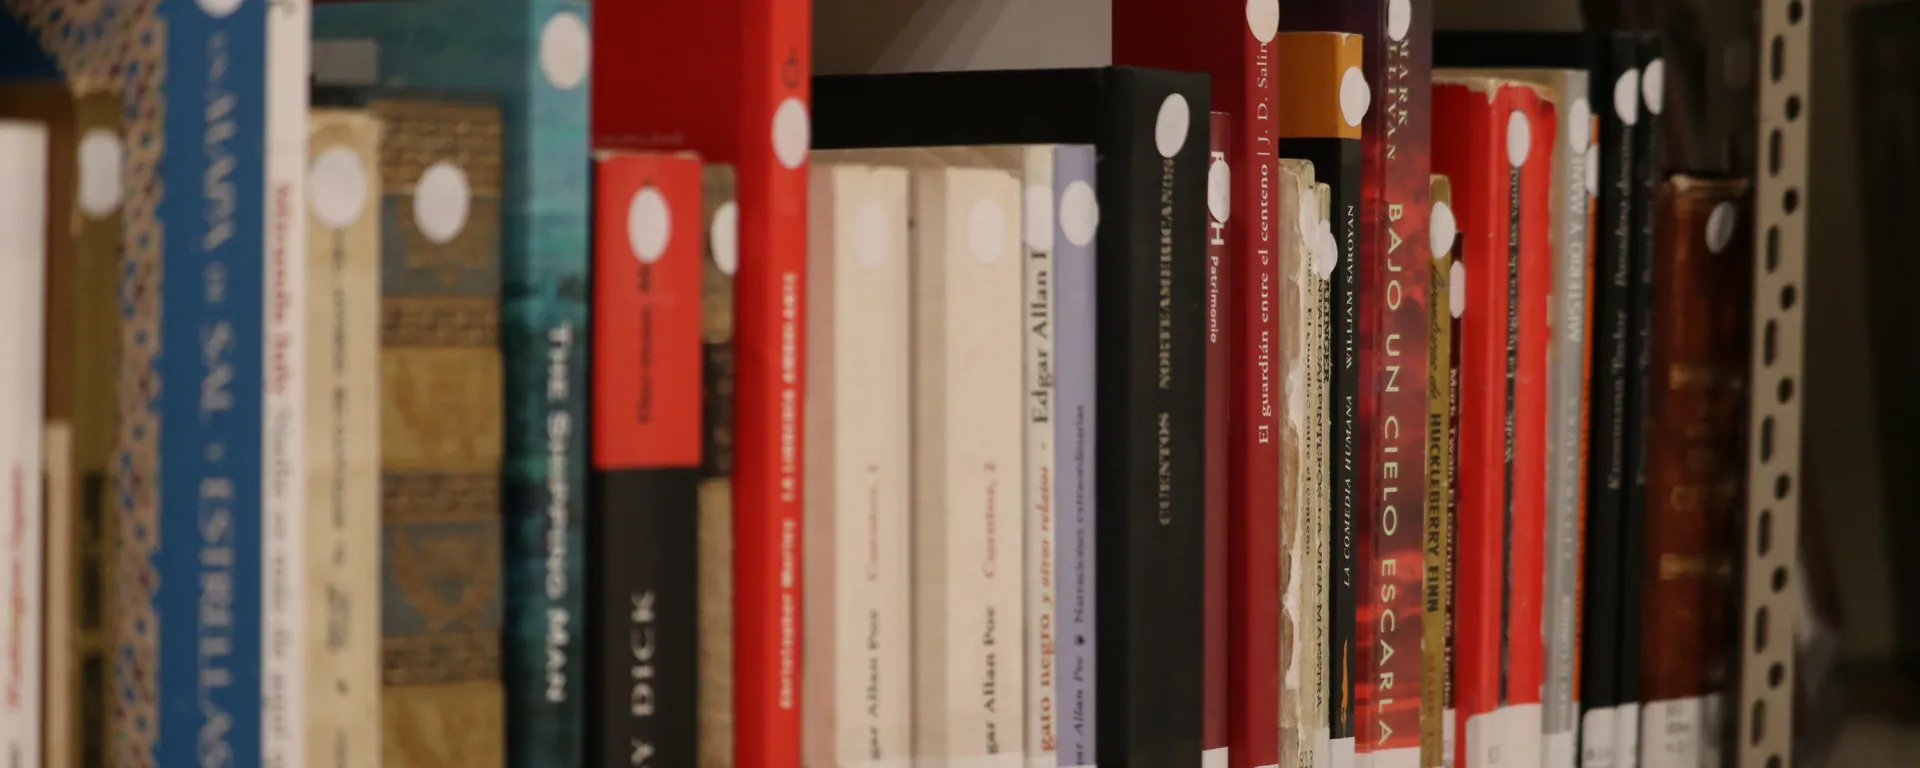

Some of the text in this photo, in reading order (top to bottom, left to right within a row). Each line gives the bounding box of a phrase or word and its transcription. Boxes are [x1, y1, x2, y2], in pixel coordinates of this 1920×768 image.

[1258, 98, 1269, 121] D.
[1258, 129, 1270, 145] J.
[1259, 164, 1269, 242] centeno
[1258, 248, 1268, 266] el
[1031, 270, 1049, 341] Allan
[1209, 255, 1220, 343] Patrimonio
[1259, 272, 1268, 323] entre
[1031, 348, 1054, 424] Edgar
[1257, 330, 1271, 417] guardián
[1343, 204, 1355, 588] LA COMEDIA HUMANA WILLIAM SAROYAN
[1072, 404, 1085, 525] extraordinarias
[1258, 424, 1268, 444] El
[1036, 465, 1051, 532] relatos
[1157, 412, 1172, 526] CUENTOS
[1378, 203, 1403, 746] BAJO UN CIELO ESCARLA
[1428, 413, 1441, 557] HUCKLEBERRY
[544, 321, 575, 703] THE SHIPPING MAN
[1038, 538, 1050, 589] otros
[1072, 527, 1084, 623] Narraciones
[1427, 565, 1439, 614] FINN
[631, 588, 656, 718] DICK
[866, 608, 880, 651] Poe
[982, 605, 996, 646] Poe
[1038, 613, 1055, 688] negro
[866, 657, 880, 718] Allan
[982, 653, 997, 713] Allan
[1072, 655, 1082, 682] Poe
[1038, 696, 1055, 753] gato
[1071, 688, 1083, 737] Allan
